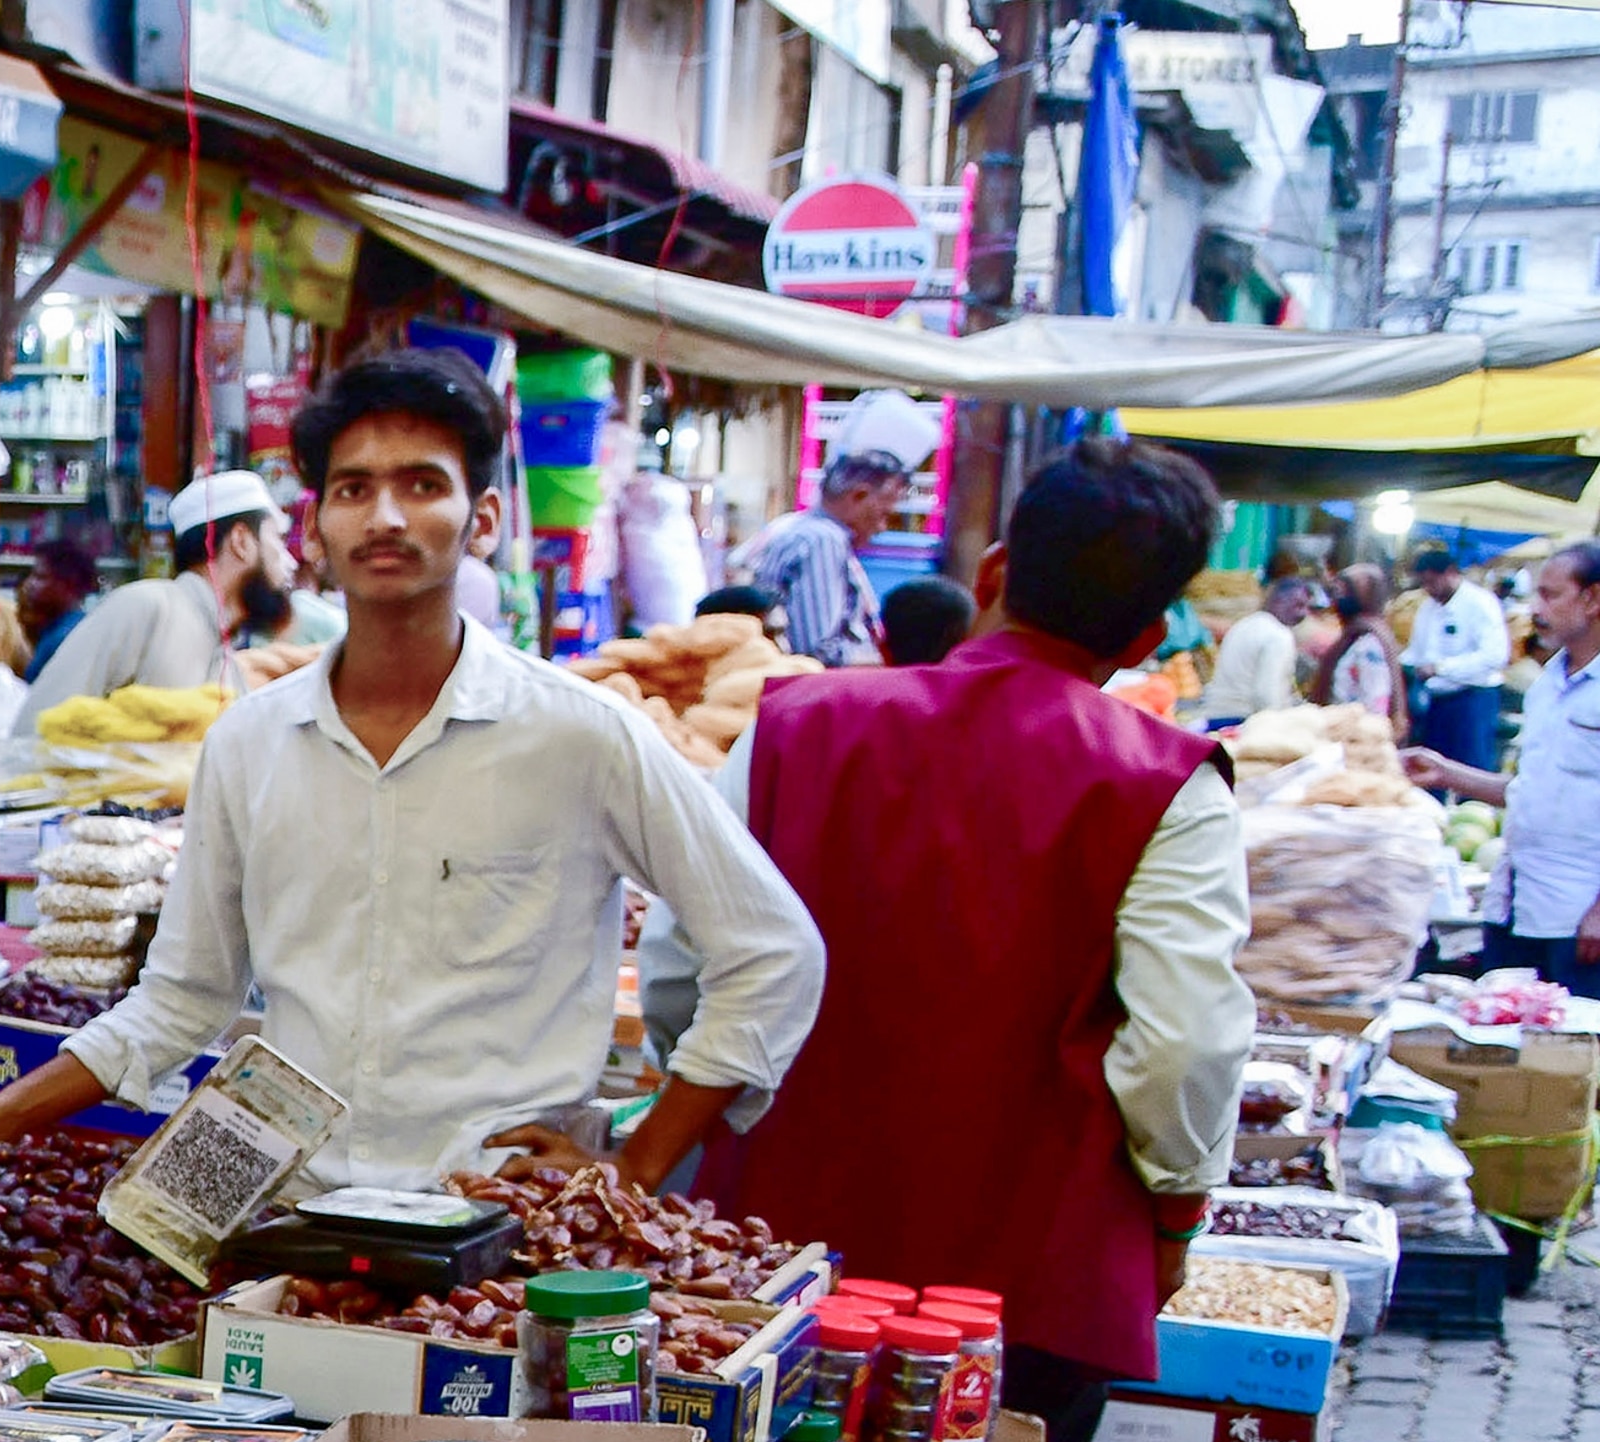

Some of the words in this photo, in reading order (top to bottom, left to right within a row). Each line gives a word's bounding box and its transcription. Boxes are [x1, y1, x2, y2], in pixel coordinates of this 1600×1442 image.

[1156, 56, 1255, 83] STORES
[771, 233, 927, 275] Hawkins
[226, 1340, 265, 1353] SAUDI
[441, 1382, 493, 1398] NATURAL
